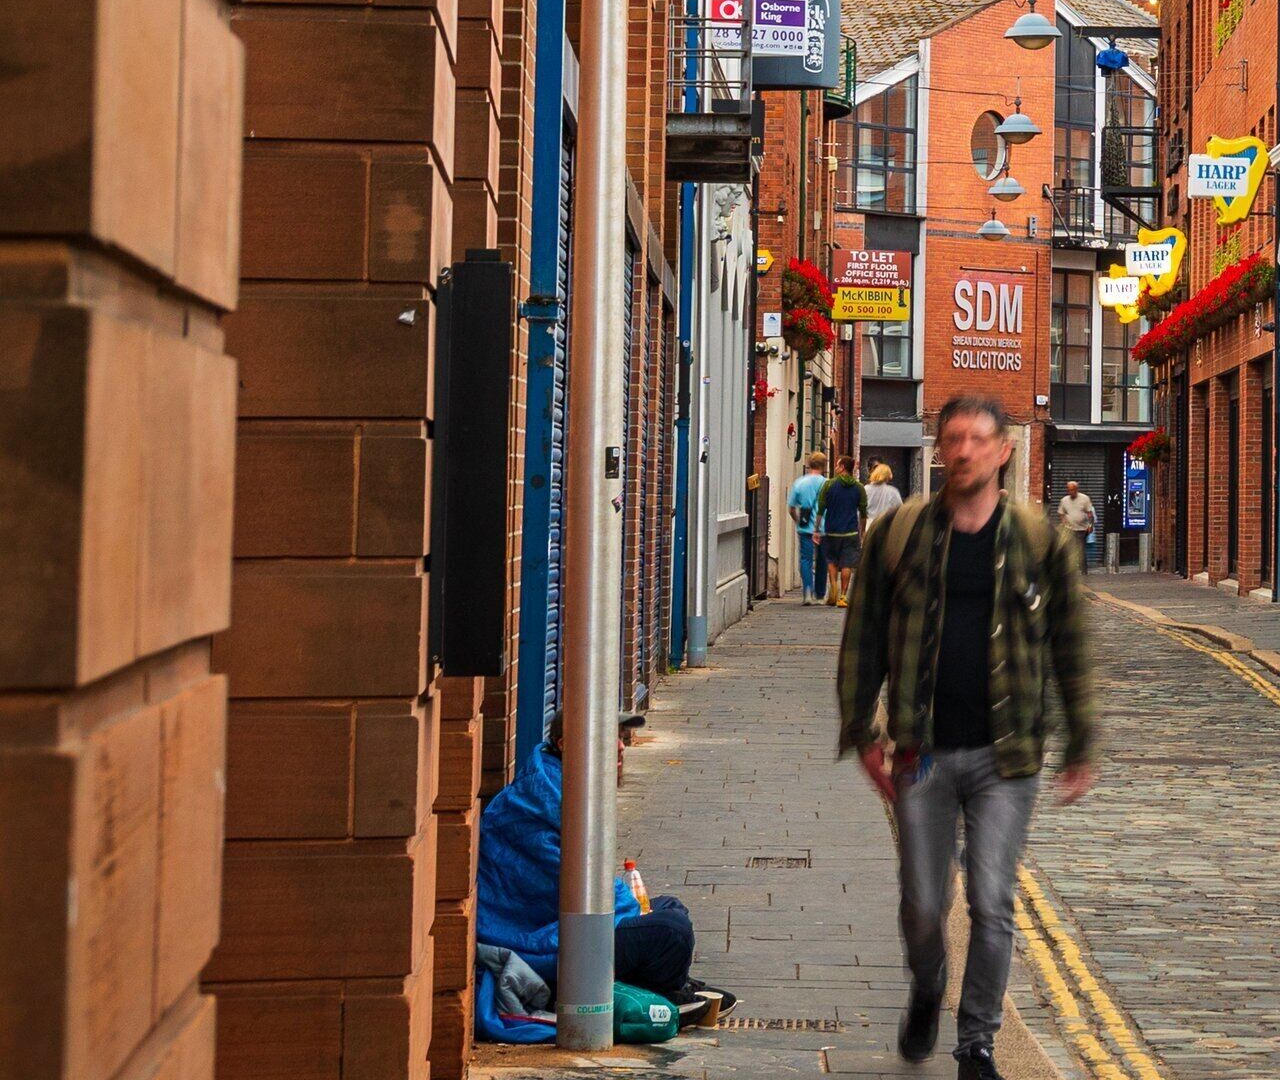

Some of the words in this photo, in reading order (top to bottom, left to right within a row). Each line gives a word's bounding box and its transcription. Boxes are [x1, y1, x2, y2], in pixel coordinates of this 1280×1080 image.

[761, 2, 801, 13] Osborne
[761, 12, 782, 23] King
[772, 30, 803, 41] 0000
[1197, 164, 1246, 180] HARP
[1206, 181, 1237, 190] LAGER
[850, 251, 869, 261] TO
[872, 252, 895, 263] LET
[1133, 250, 1169, 262] HARP
[847, 262, 869, 270] FIRST
[871, 263, 898, 271] FLOOR
[875, 271, 899, 279] SUITE
[842, 290, 893, 301] McKIBBIN
[857, 306, 874, 314] 500
[878, 306, 892, 314] 100
[953, 279, 1023, 333] SDM
[972, 336, 997, 347] DICKSON
[953, 349, 1022, 371] SOLICITORS
[1131, 461, 1145, 470] ATM
